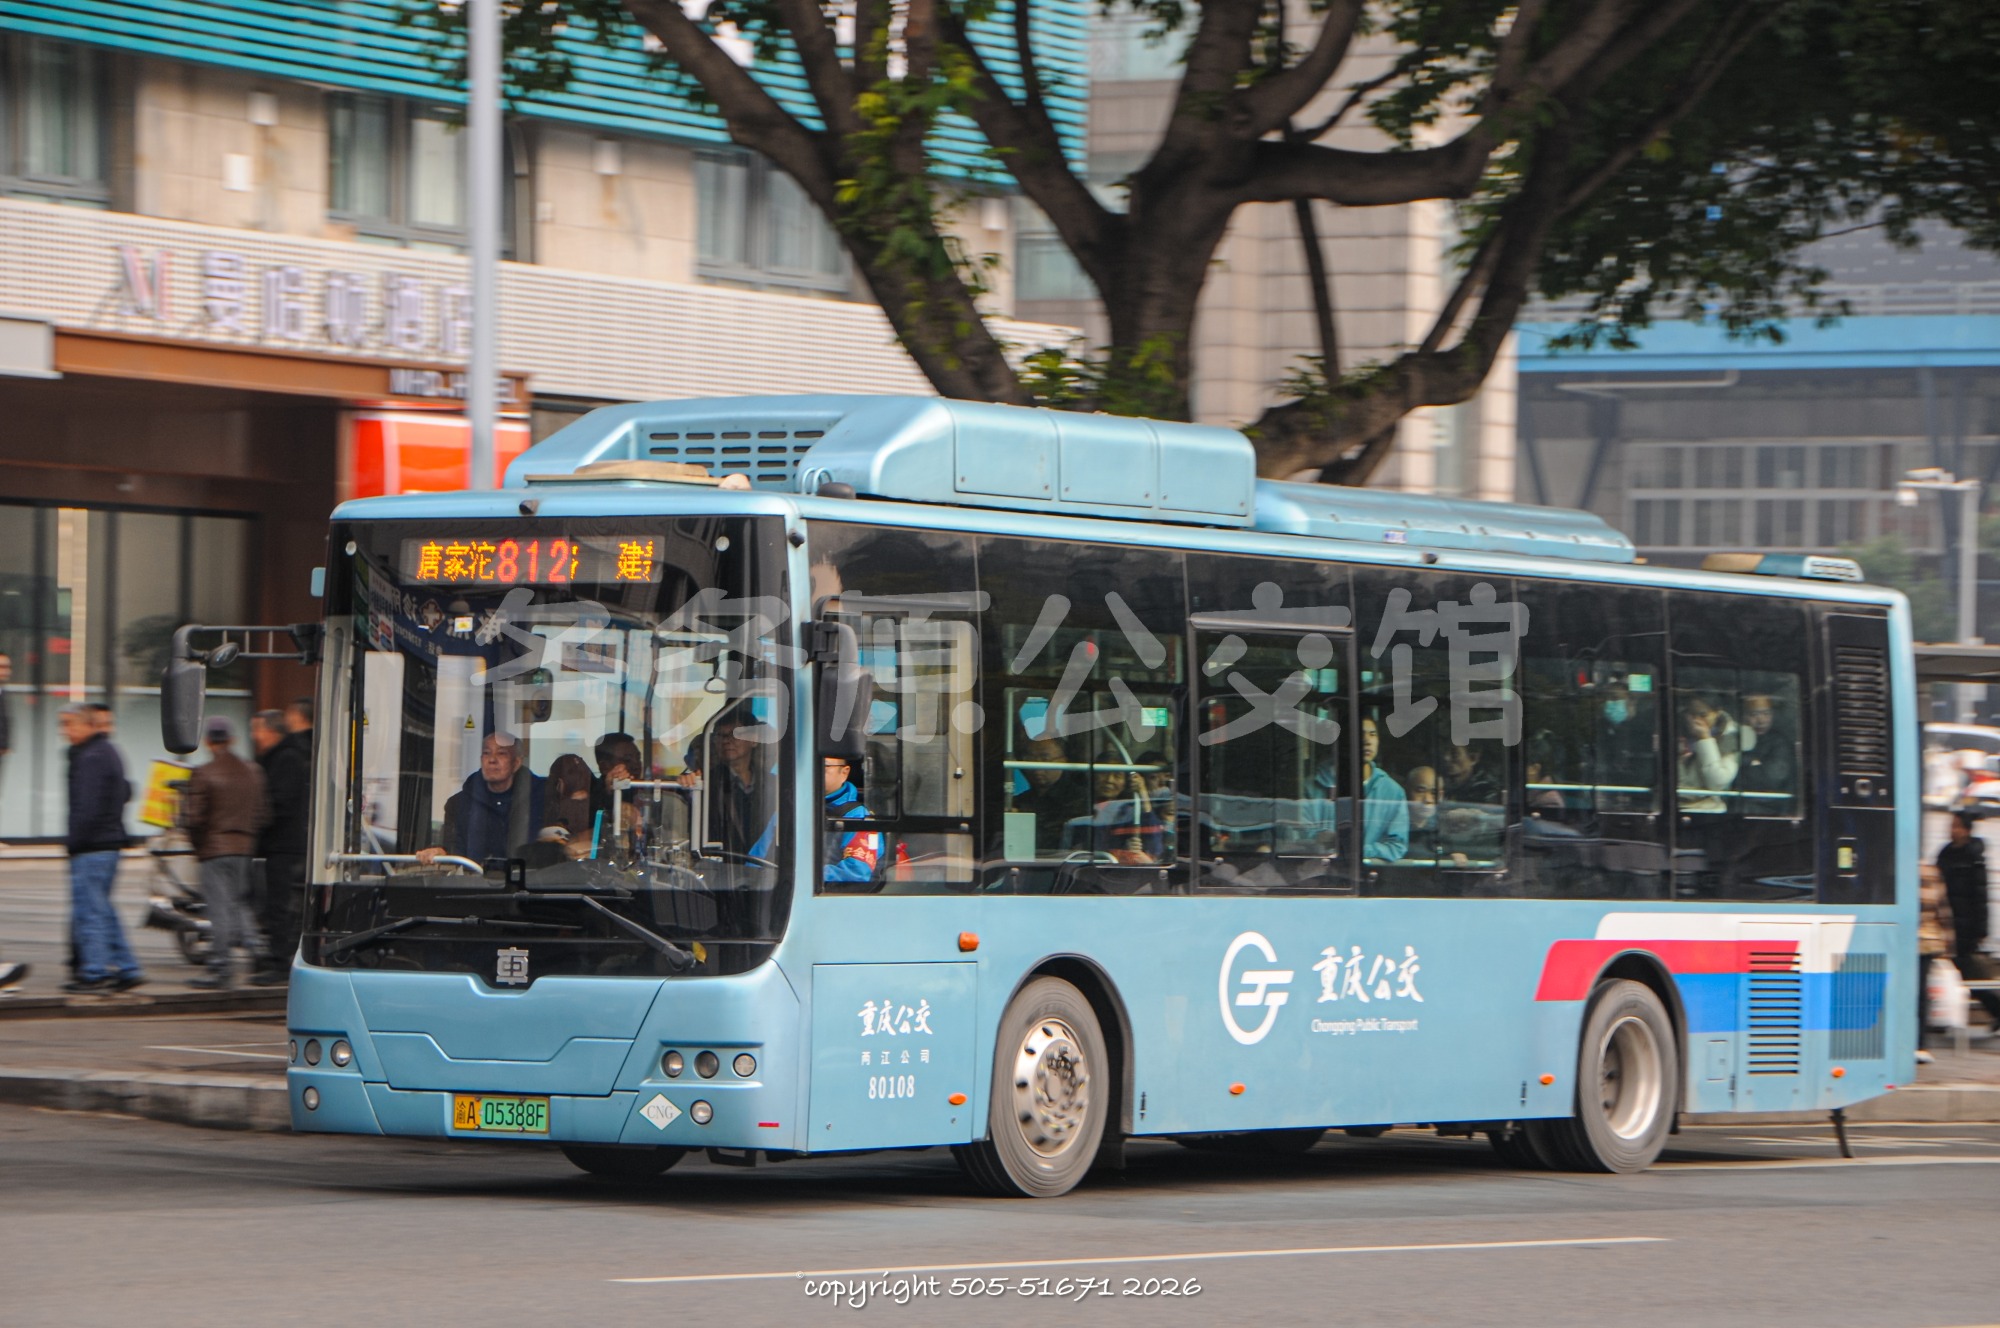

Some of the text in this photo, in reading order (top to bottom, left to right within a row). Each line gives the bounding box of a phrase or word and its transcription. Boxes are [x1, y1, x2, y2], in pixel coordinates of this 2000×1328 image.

[416, 541, 496, 581] 唐家沱
[497, 540, 567, 582] 812
[1311, 945, 1424, 1003] 重庆公交
[857, 998, 933, 1037] 重庆公交
[1310, 1018, 1419, 1035] Chongqing Public Transport
[861, 1049, 930, 1066] 两江公司
[868, 1074, 915, 1100] 80108
[485, 1101, 546, 1127] 05388F
[646, 1105, 674, 1120] CNG
